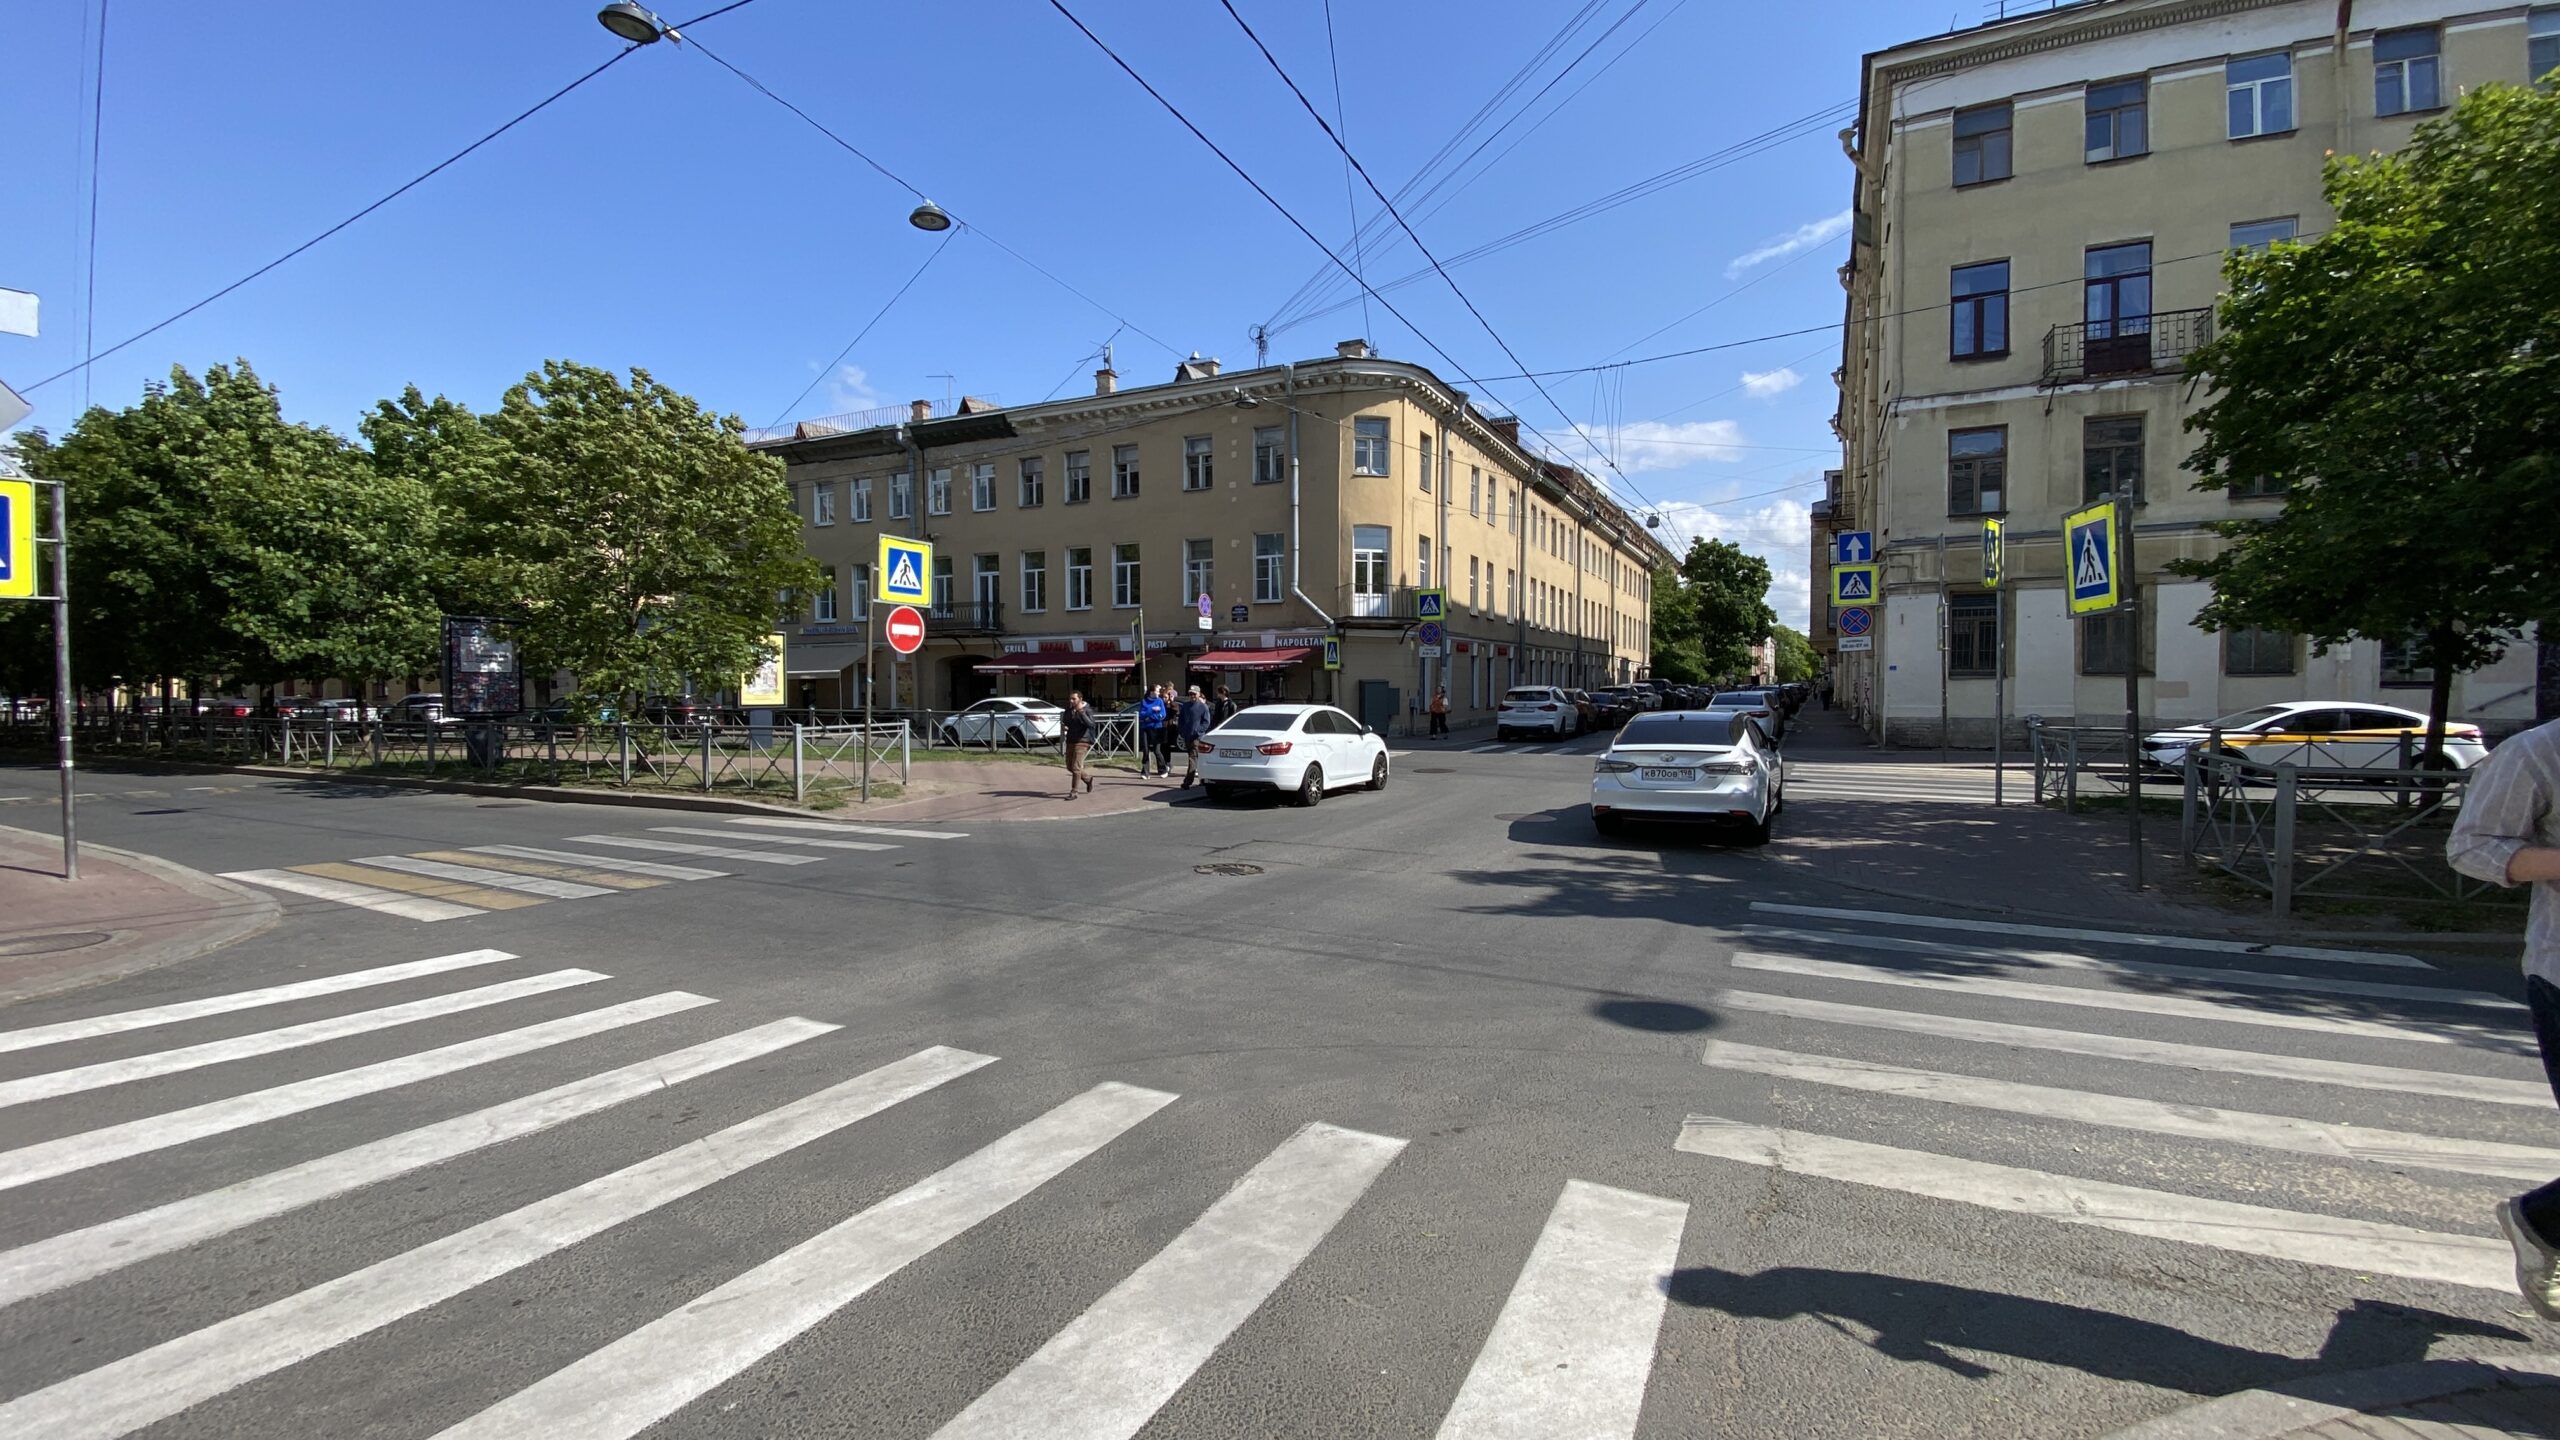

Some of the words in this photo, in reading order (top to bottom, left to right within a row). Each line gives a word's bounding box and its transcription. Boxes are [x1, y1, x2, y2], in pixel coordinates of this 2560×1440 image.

[1147, 640, 1168, 649] PASTA
[1223, 639, 1246, 648] PIZZA
[1277, 637, 1325, 647] NAPOLETAN
[1004, 644, 1025, 654] GRILL
